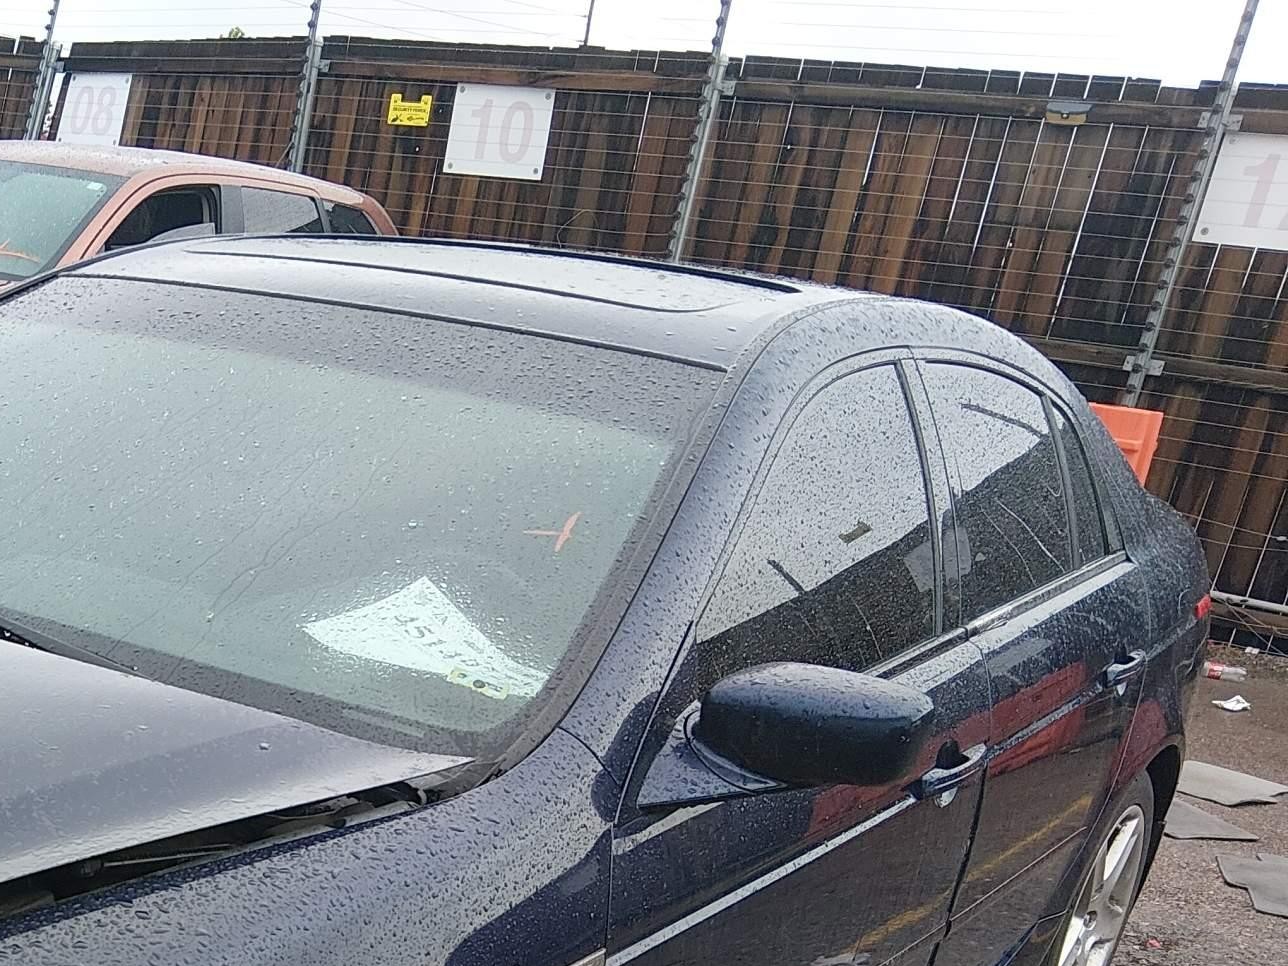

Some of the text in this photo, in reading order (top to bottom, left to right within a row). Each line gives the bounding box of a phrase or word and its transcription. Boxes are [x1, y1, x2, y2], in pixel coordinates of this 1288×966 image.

[72, 86, 116, 135] 08
[472, 99, 534, 163] 10
[1243, 154, 1288, 228] 1
